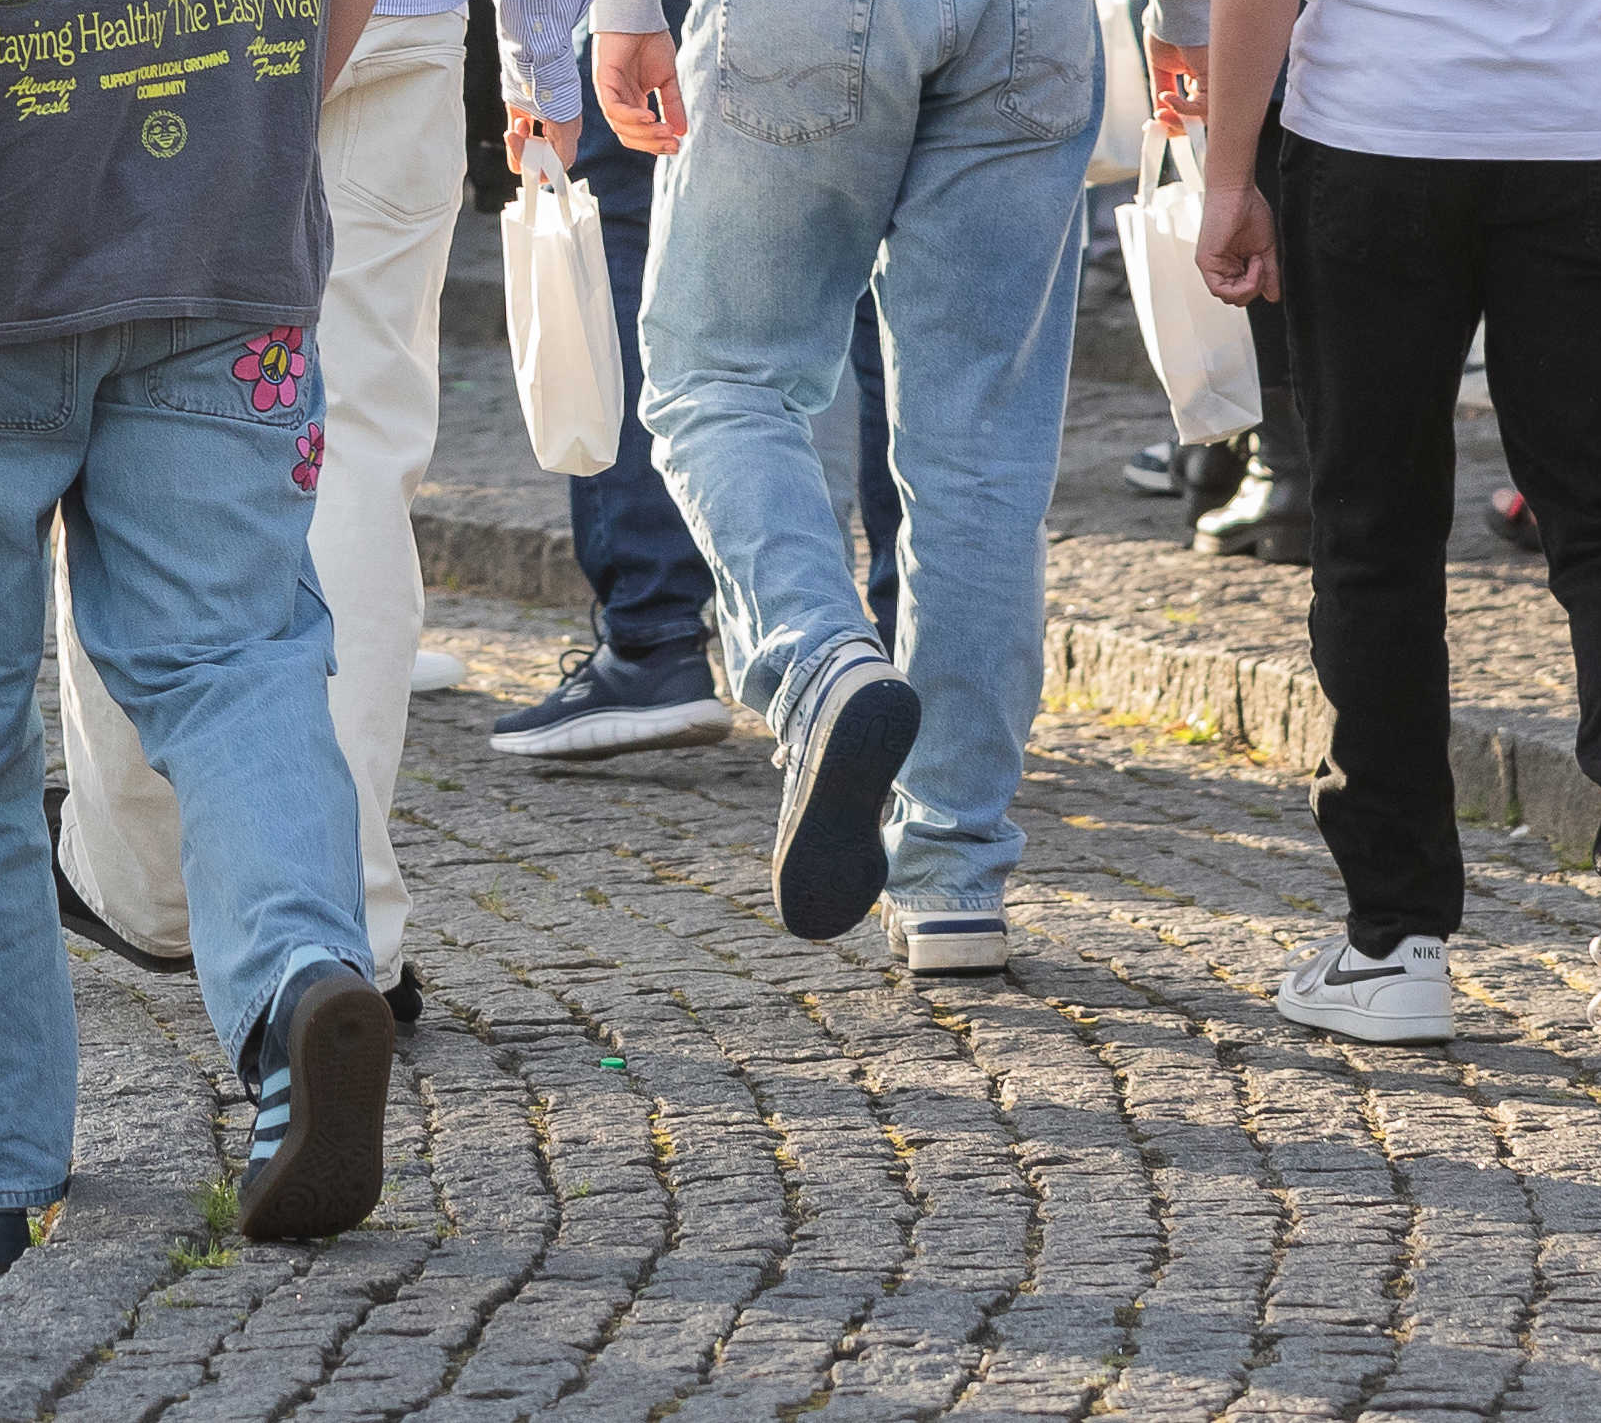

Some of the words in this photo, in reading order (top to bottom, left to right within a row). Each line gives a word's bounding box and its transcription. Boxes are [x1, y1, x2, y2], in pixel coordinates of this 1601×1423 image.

[77, 0, 168, 54] Healthy
[245, 35, 307, 59] Always
[158, 59, 185, 77] LOCAL
[183, 49, 231, 73] GROWING
[252, 53, 303, 82] Fresh
[4, 75, 78, 99] Always
[136, 79, 187, 100] COMMUNITY
[16, 92, 71, 122] Fresh
[1412, 946, 1441, 960] NIKE
